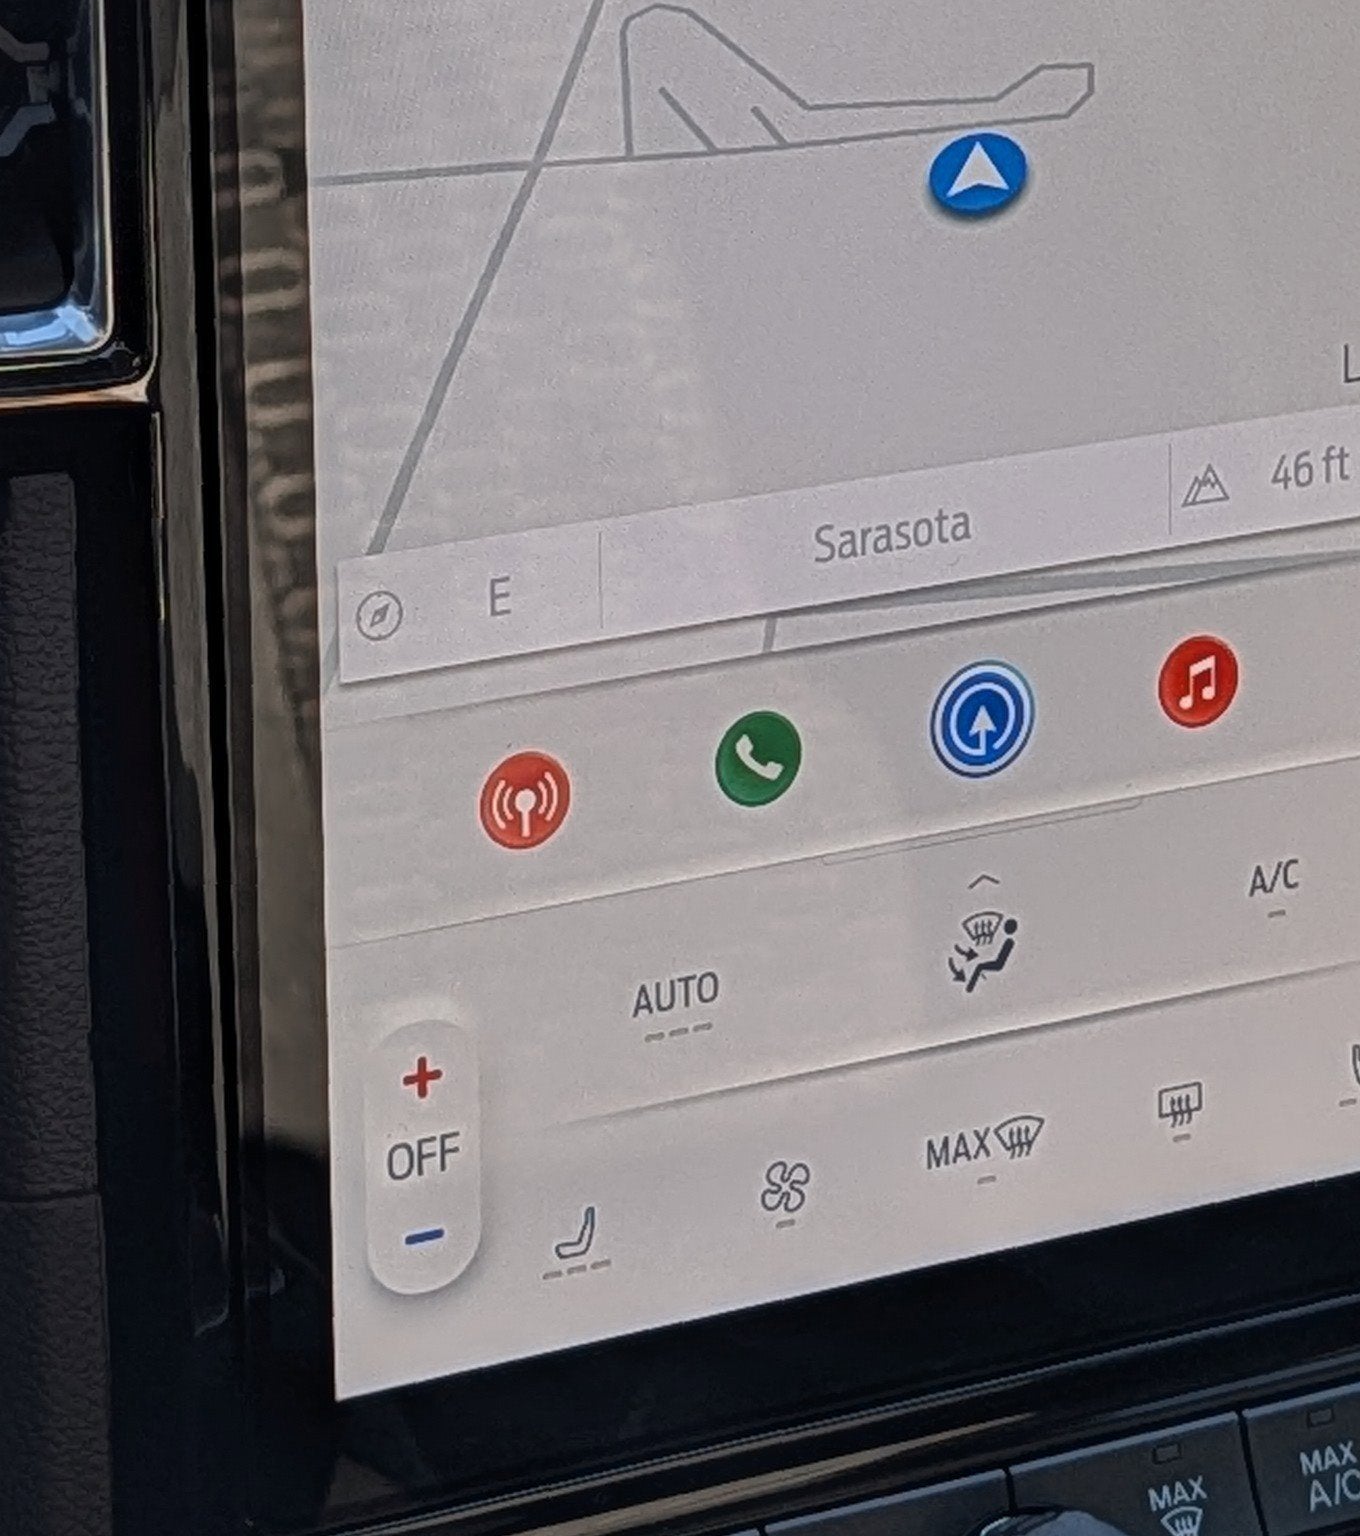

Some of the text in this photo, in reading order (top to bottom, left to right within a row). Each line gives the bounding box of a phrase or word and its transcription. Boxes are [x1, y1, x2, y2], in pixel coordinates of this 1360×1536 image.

[1271, 446, 1351, 491] 46 ft
[814, 508, 972, 563] Sarasota
[489, 575, 511, 617] E
[1248, 859, 1300, 897] A/C
[632, 970, 720, 1018] AUTO
[386, 1131, 462, 1182] OFF
[926, 1127, 992, 1170] MAX
[1299, 1440, 1359, 1476] MAX
[1148, 1476, 1208, 1508] MAX
